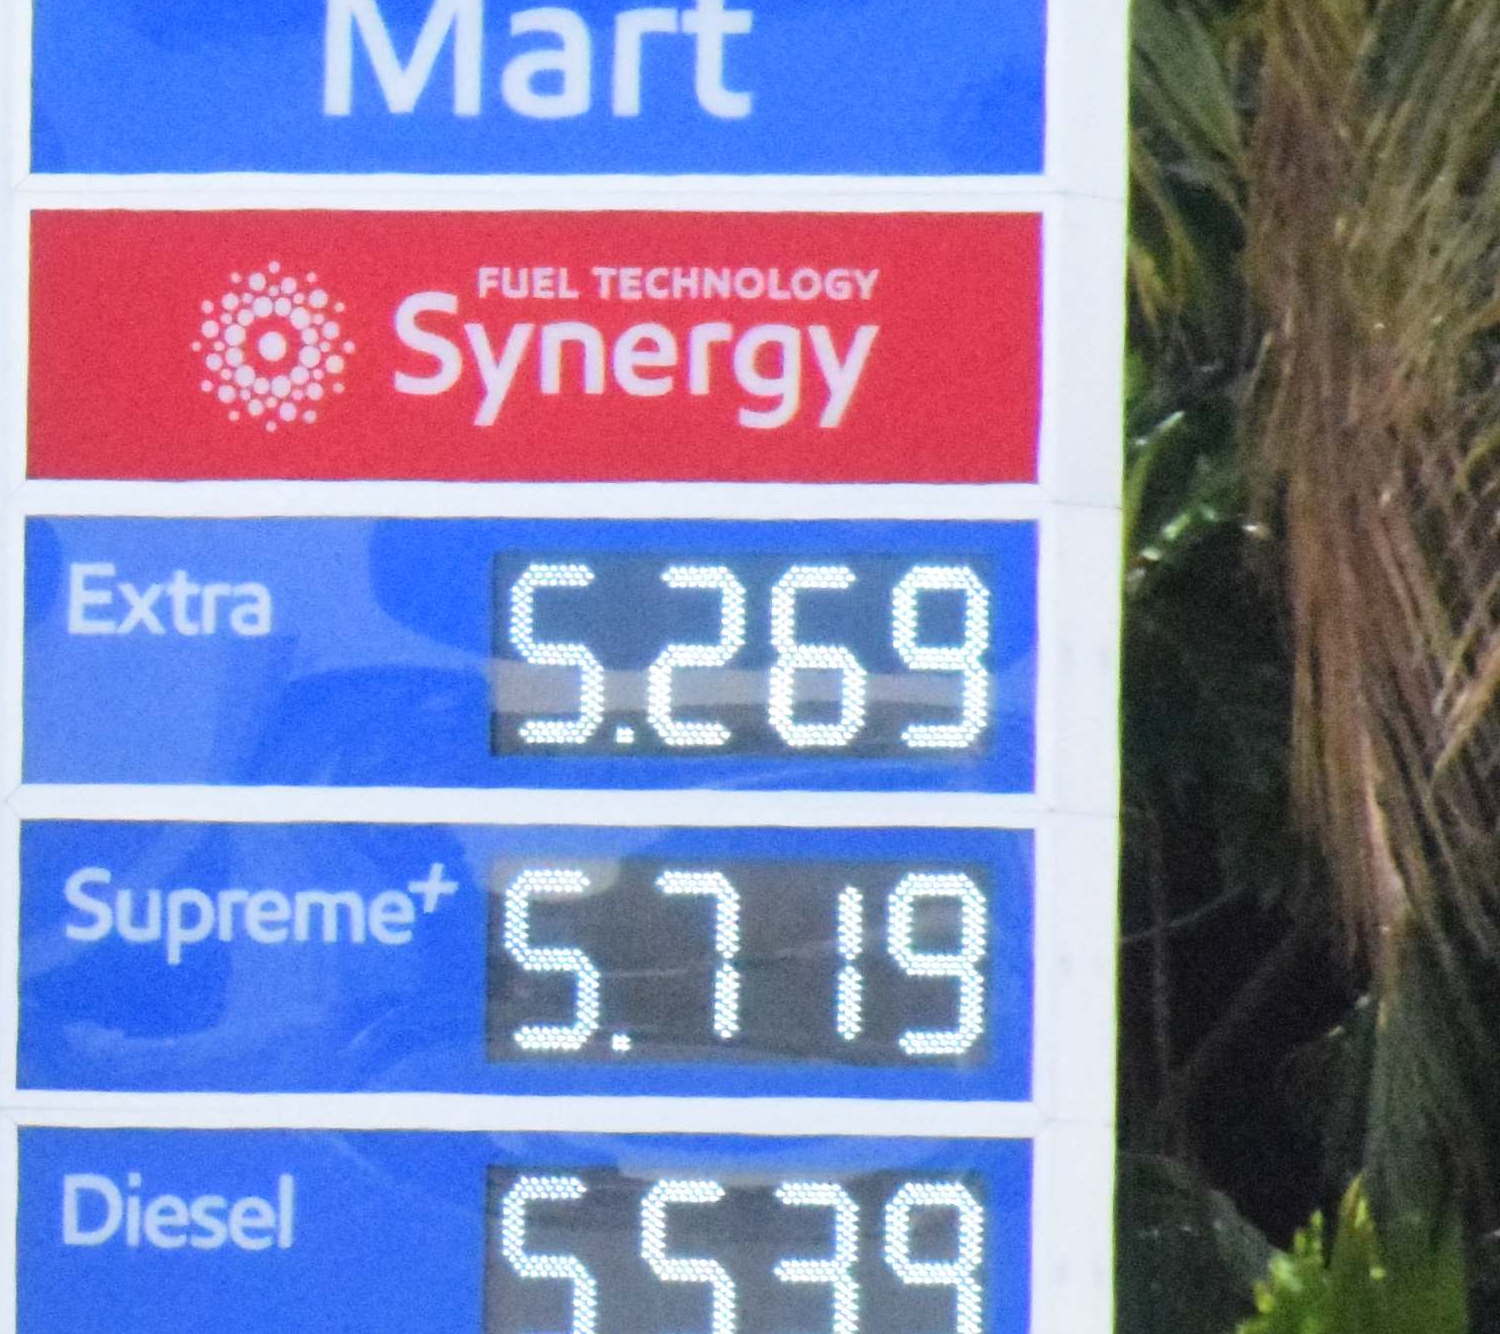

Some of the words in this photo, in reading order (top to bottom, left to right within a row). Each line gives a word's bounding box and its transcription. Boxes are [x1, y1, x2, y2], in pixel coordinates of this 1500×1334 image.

[477, 266, 579, 300] FUEL
[592, 266, 880, 302] TECHNOLOGY
[393, 290, 880, 431] Synergy
[68, 563, 273, 637] Extra
[509, 562, 990, 749] 5.269
[503, 867, 987, 1056] 5.719
[62, 1175, 294, 1250] Diesel
